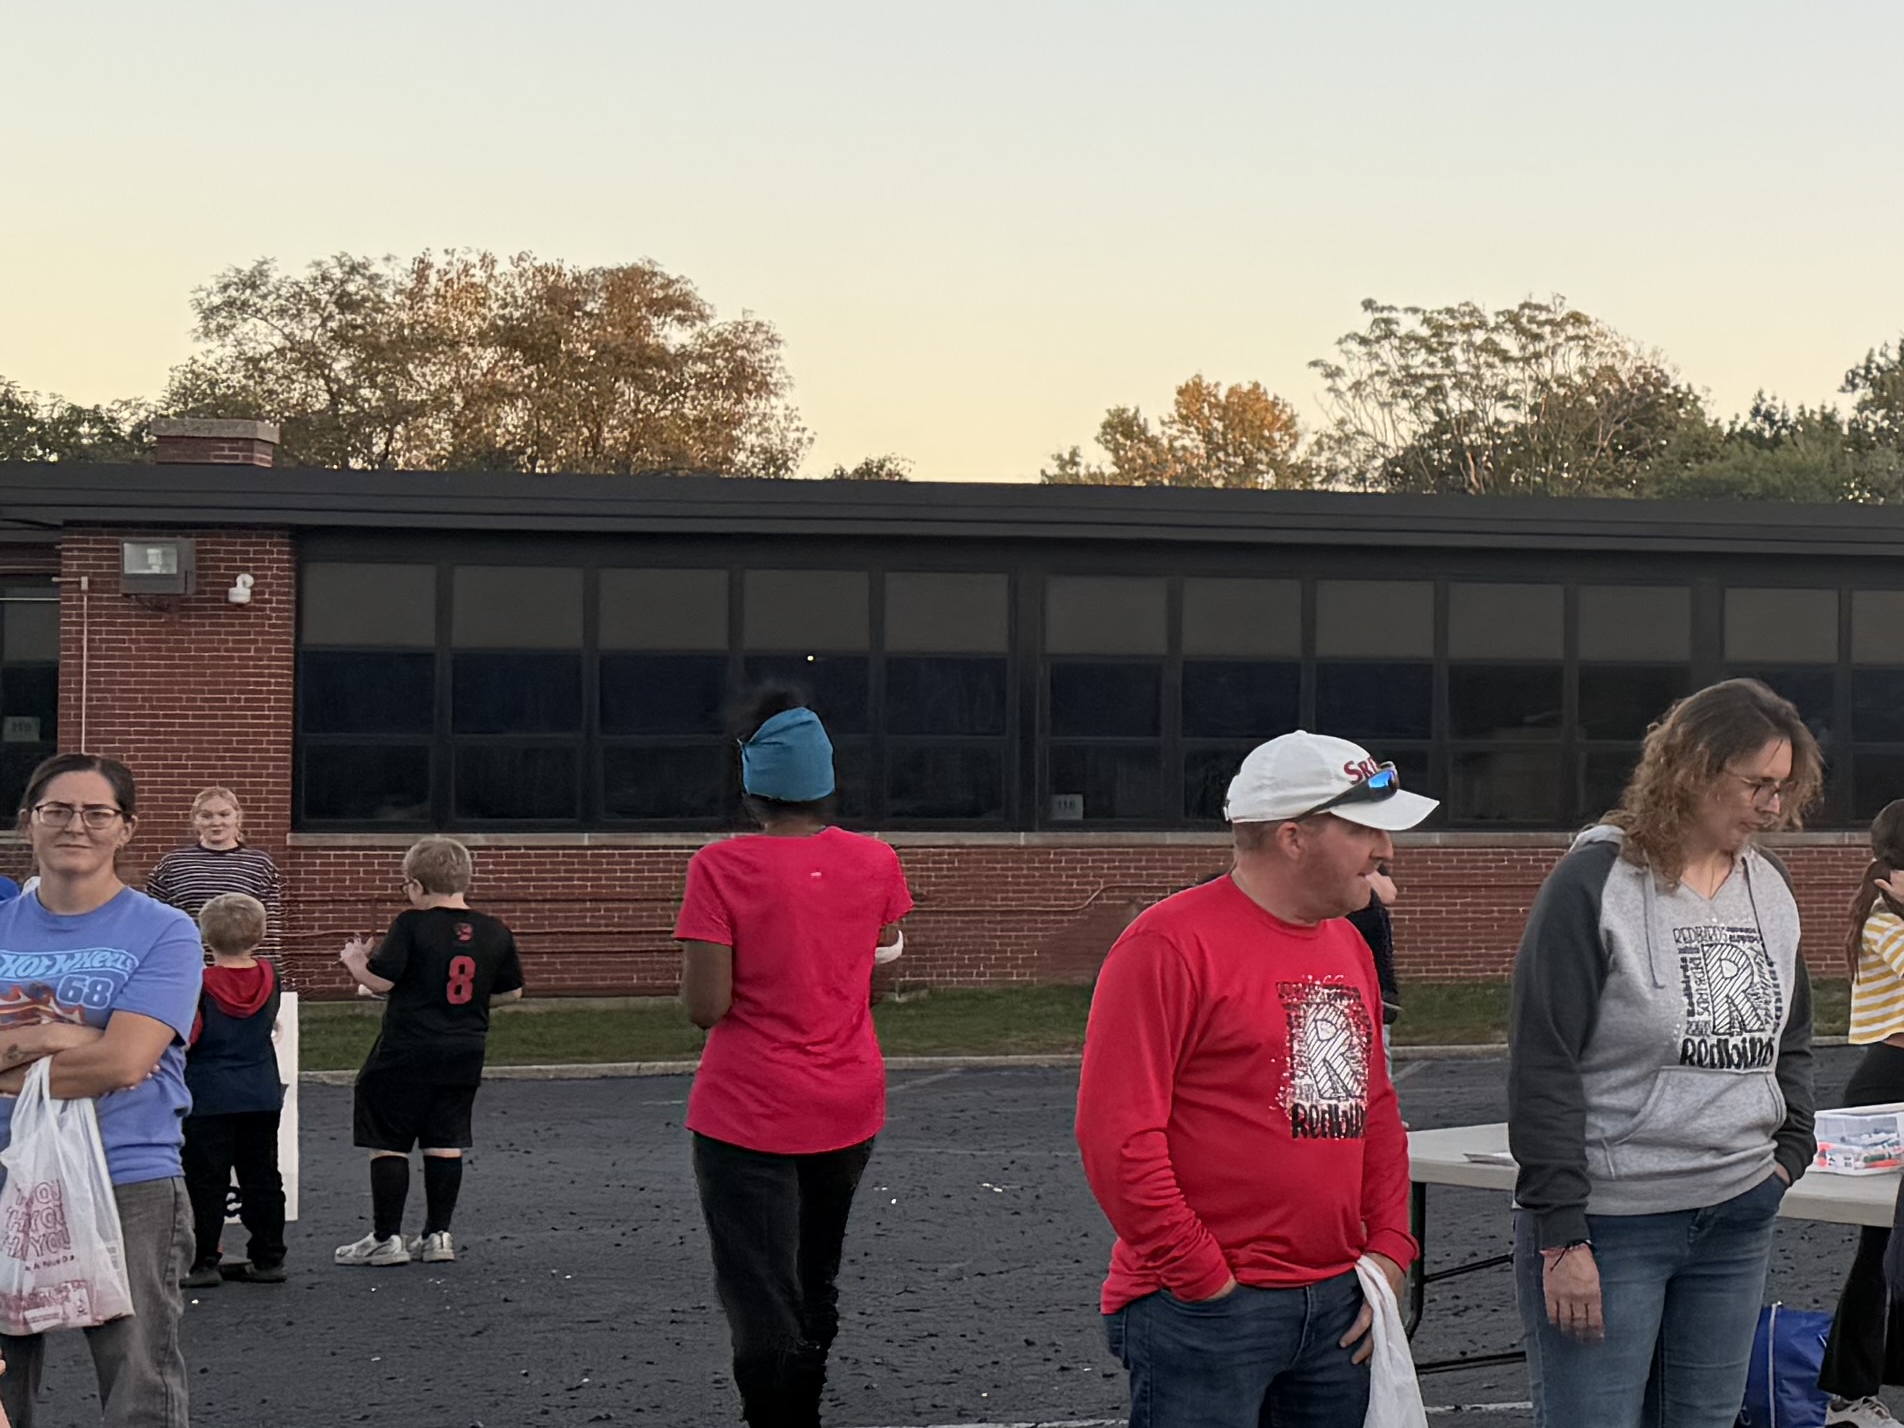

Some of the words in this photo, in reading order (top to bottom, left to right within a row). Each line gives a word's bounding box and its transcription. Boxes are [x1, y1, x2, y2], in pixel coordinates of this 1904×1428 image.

[56, 974, 114, 1009] 68
[446, 955, 476, 1005] 8
[1701, 943, 1766, 1034] R
